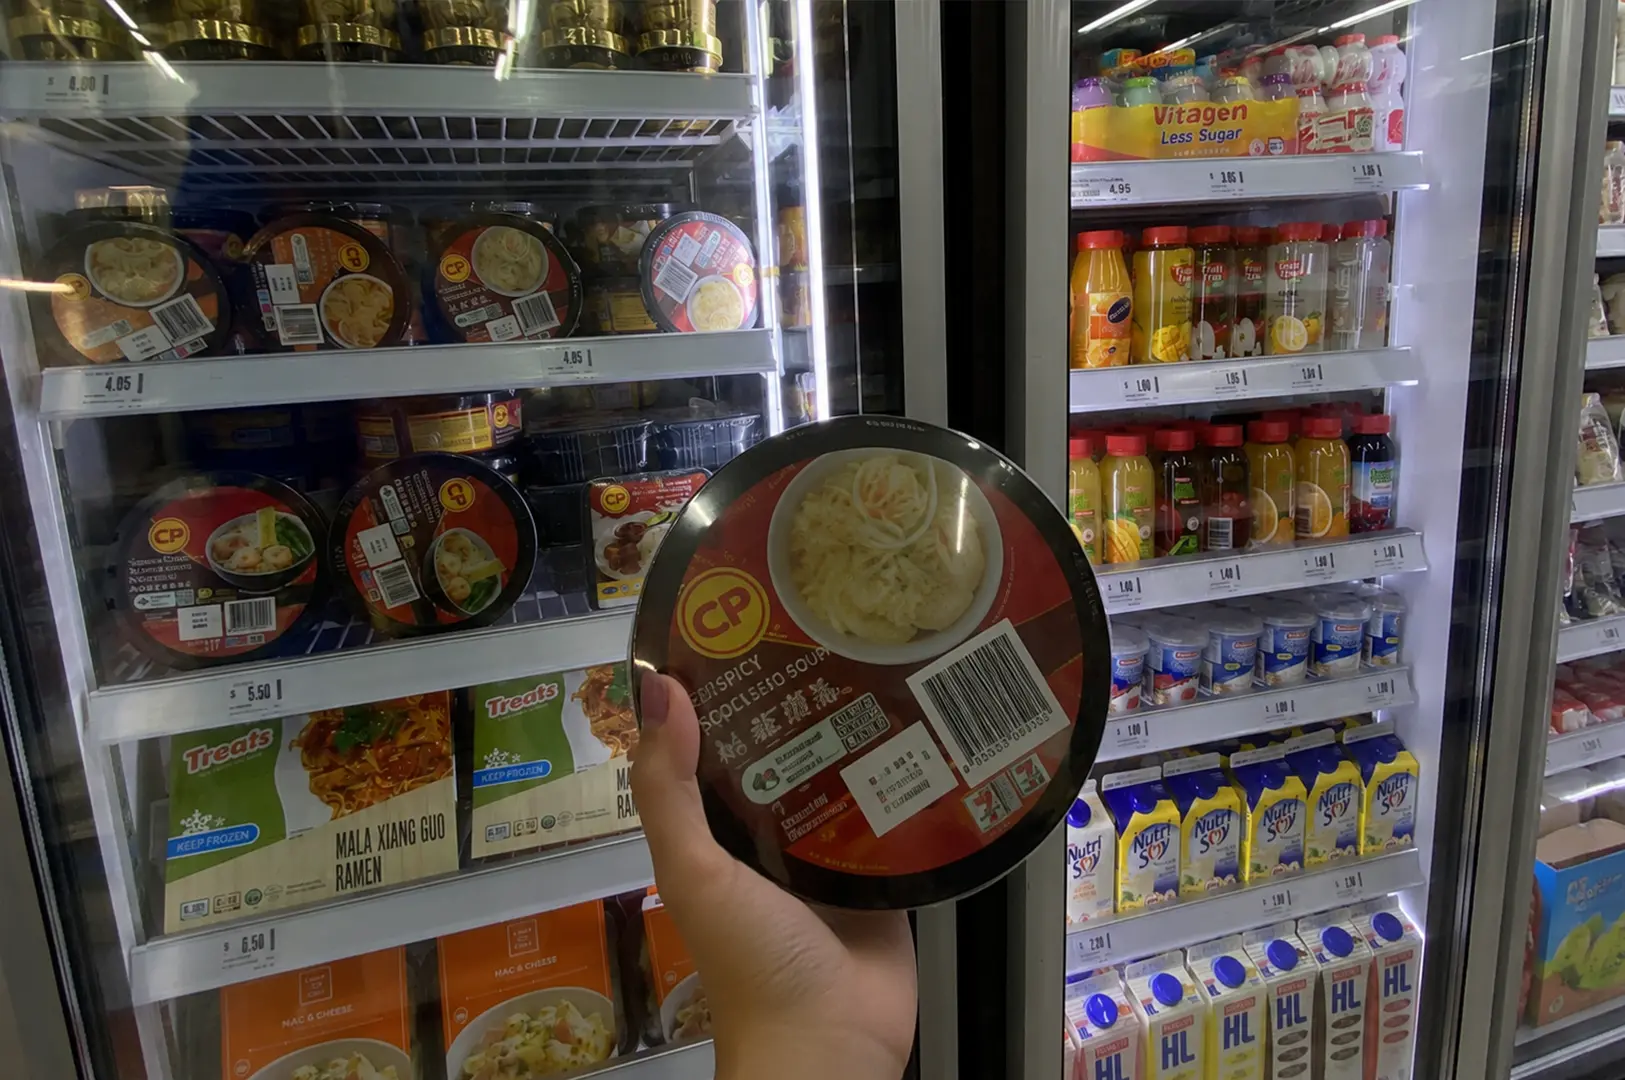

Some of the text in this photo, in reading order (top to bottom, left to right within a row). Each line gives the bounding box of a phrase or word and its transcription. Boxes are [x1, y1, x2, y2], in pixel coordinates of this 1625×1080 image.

[1153, 103, 1248, 126] Vitagen
[1161, 128, 1243, 145] Less Sugar
[445, 261, 466, 276] CP
[447, 482, 467, 507] CP
[605, 492, 626, 506] CP
[153, 528, 184, 544] CP
[692, 586, 752, 638] CP
[715, 654, 762, 692] SPICY
[247, 684, 271, 702] 5.50
[484, 682, 559, 719] Treats
[185, 730, 272, 773] Treats
[176, 828, 251, 853] KEEP FROZEN
[336, 812, 446, 860] MALA XIANG GUO
[336, 855, 382, 892] RAMEN
[242, 933, 265, 954] 6.50
[1331, 979, 1362, 1014] HL
[1384, 963, 1412, 998] HL
[1277, 992, 1308, 1030] HL
[1223, 1011, 1256, 1051] HL
[1095, 1052, 1132, 1080] HL
[1162, 1030, 1195, 1071] HL
